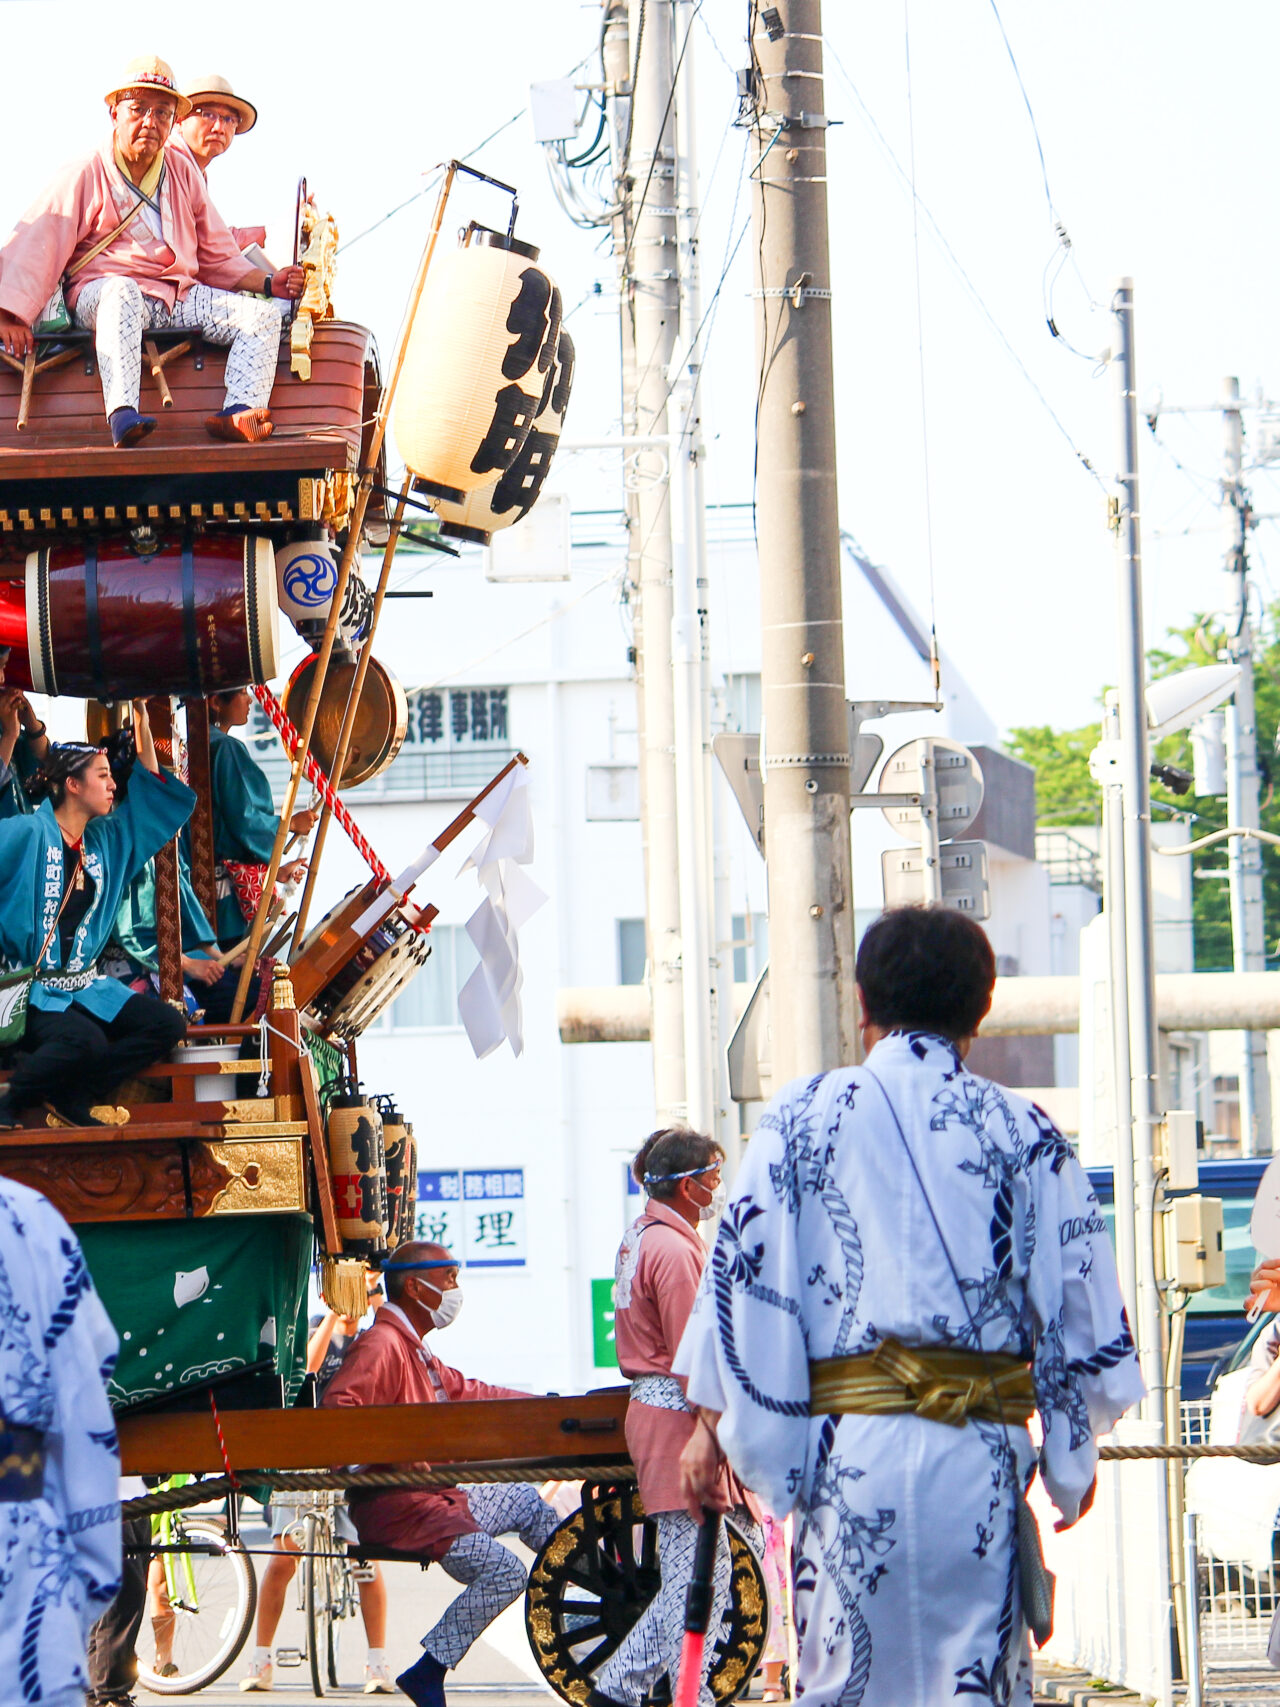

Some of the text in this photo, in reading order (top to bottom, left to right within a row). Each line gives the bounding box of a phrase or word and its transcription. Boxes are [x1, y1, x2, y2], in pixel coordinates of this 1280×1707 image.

[417, 1173, 523, 1199] ・税務相談
